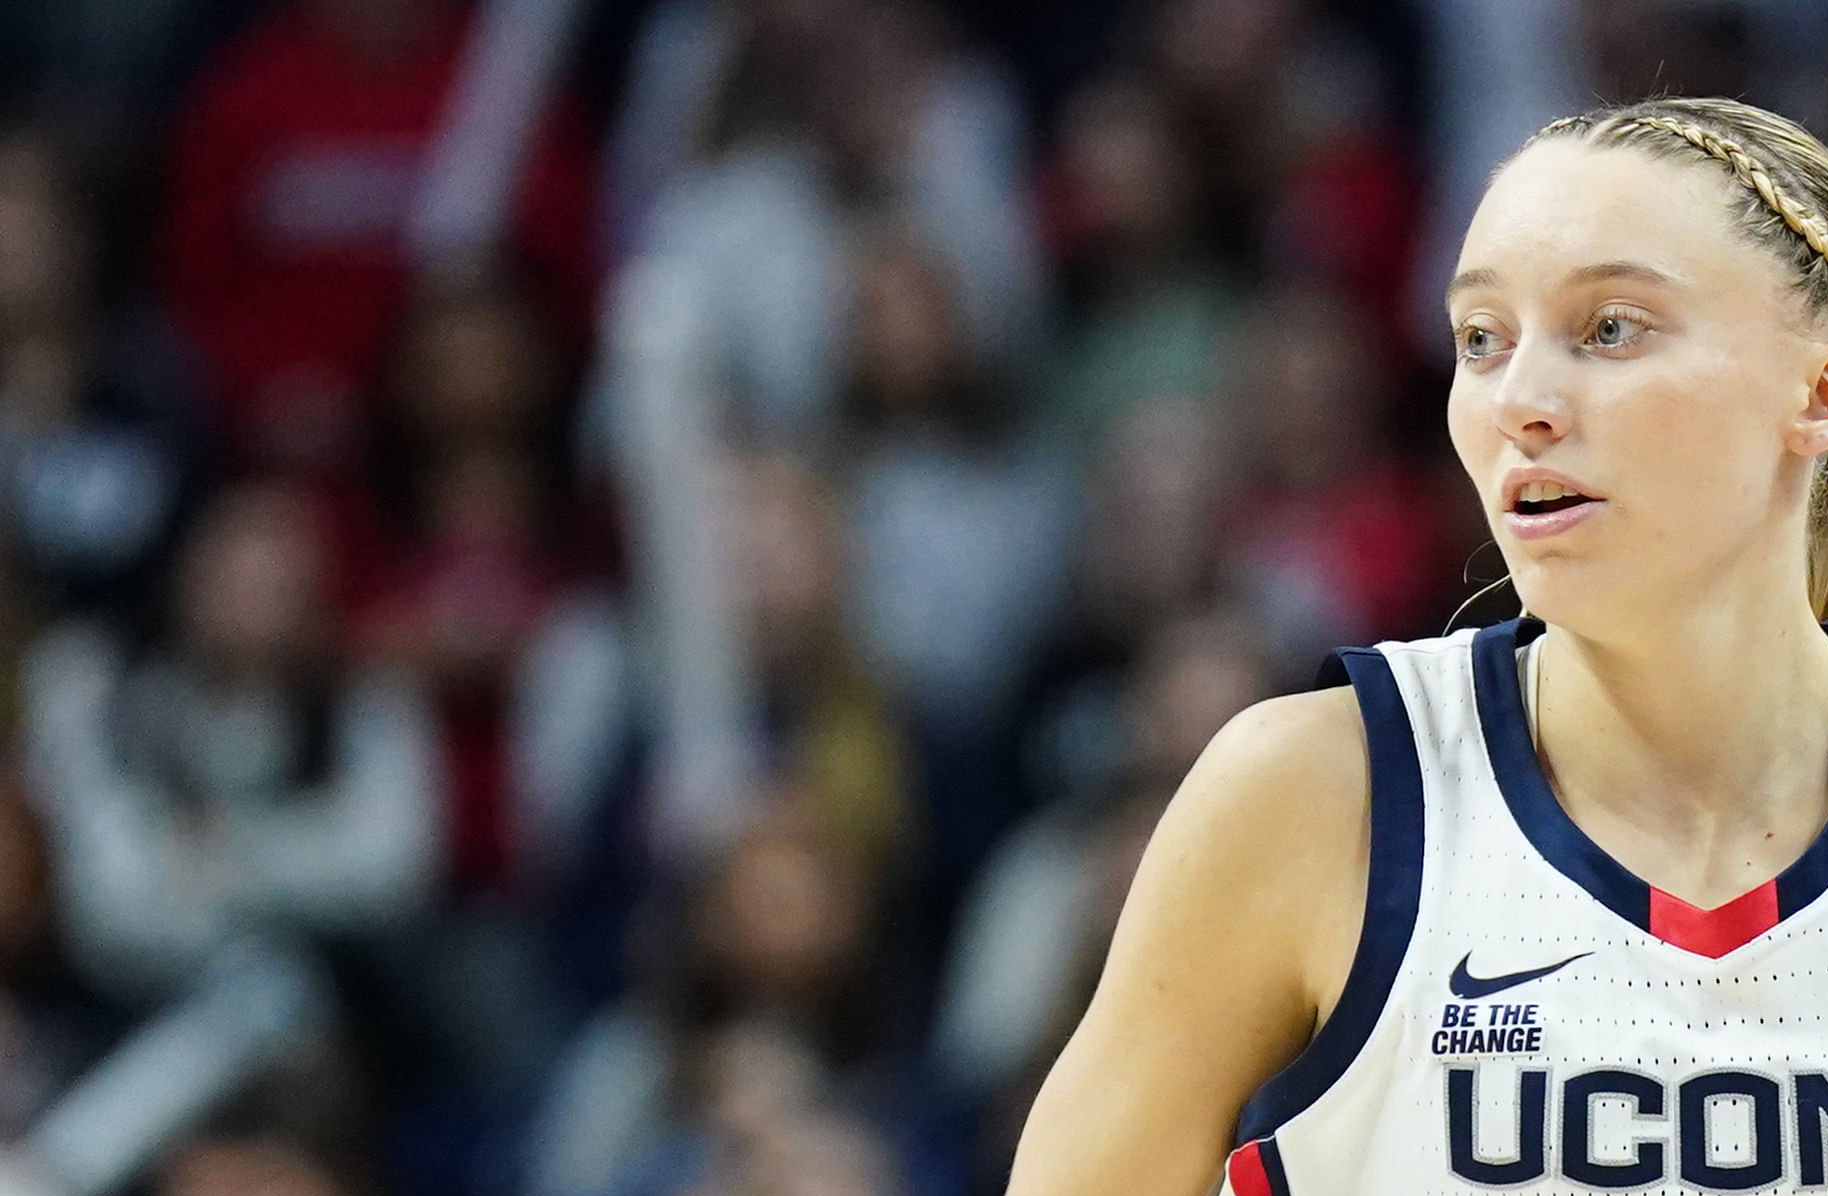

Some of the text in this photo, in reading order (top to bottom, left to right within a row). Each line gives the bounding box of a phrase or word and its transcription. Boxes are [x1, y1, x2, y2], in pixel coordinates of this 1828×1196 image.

[1442, 1004, 1539, 1028] BE THE
[1431, 1027, 1542, 1055] CHANGE
